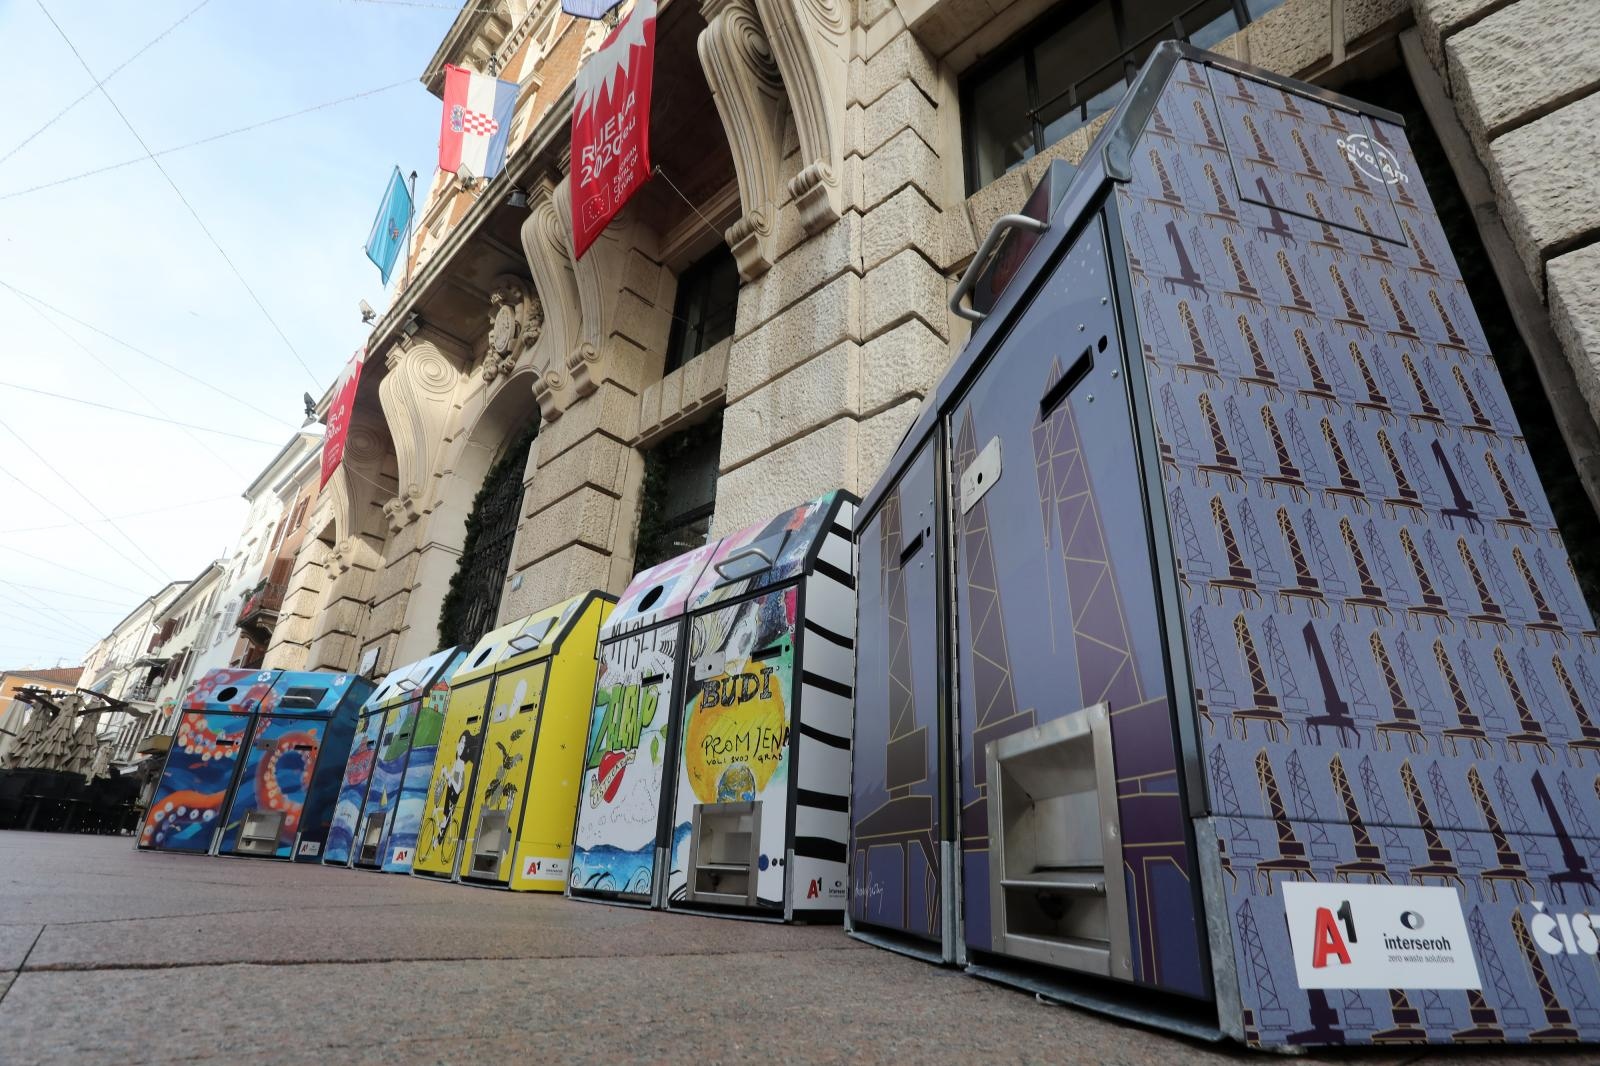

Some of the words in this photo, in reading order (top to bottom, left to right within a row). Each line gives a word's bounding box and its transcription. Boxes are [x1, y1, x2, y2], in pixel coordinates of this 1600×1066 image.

[700, 667, 773, 713] BUDI
[701, 724, 790, 758] PROMJENA
[758, 753, 783, 764] GRAD
[526, 860, 541, 875] A1
[807, 877, 822, 899] A1
[1312, 900, 1358, 968] A1
[1383, 933, 1452, 950] interseroh
